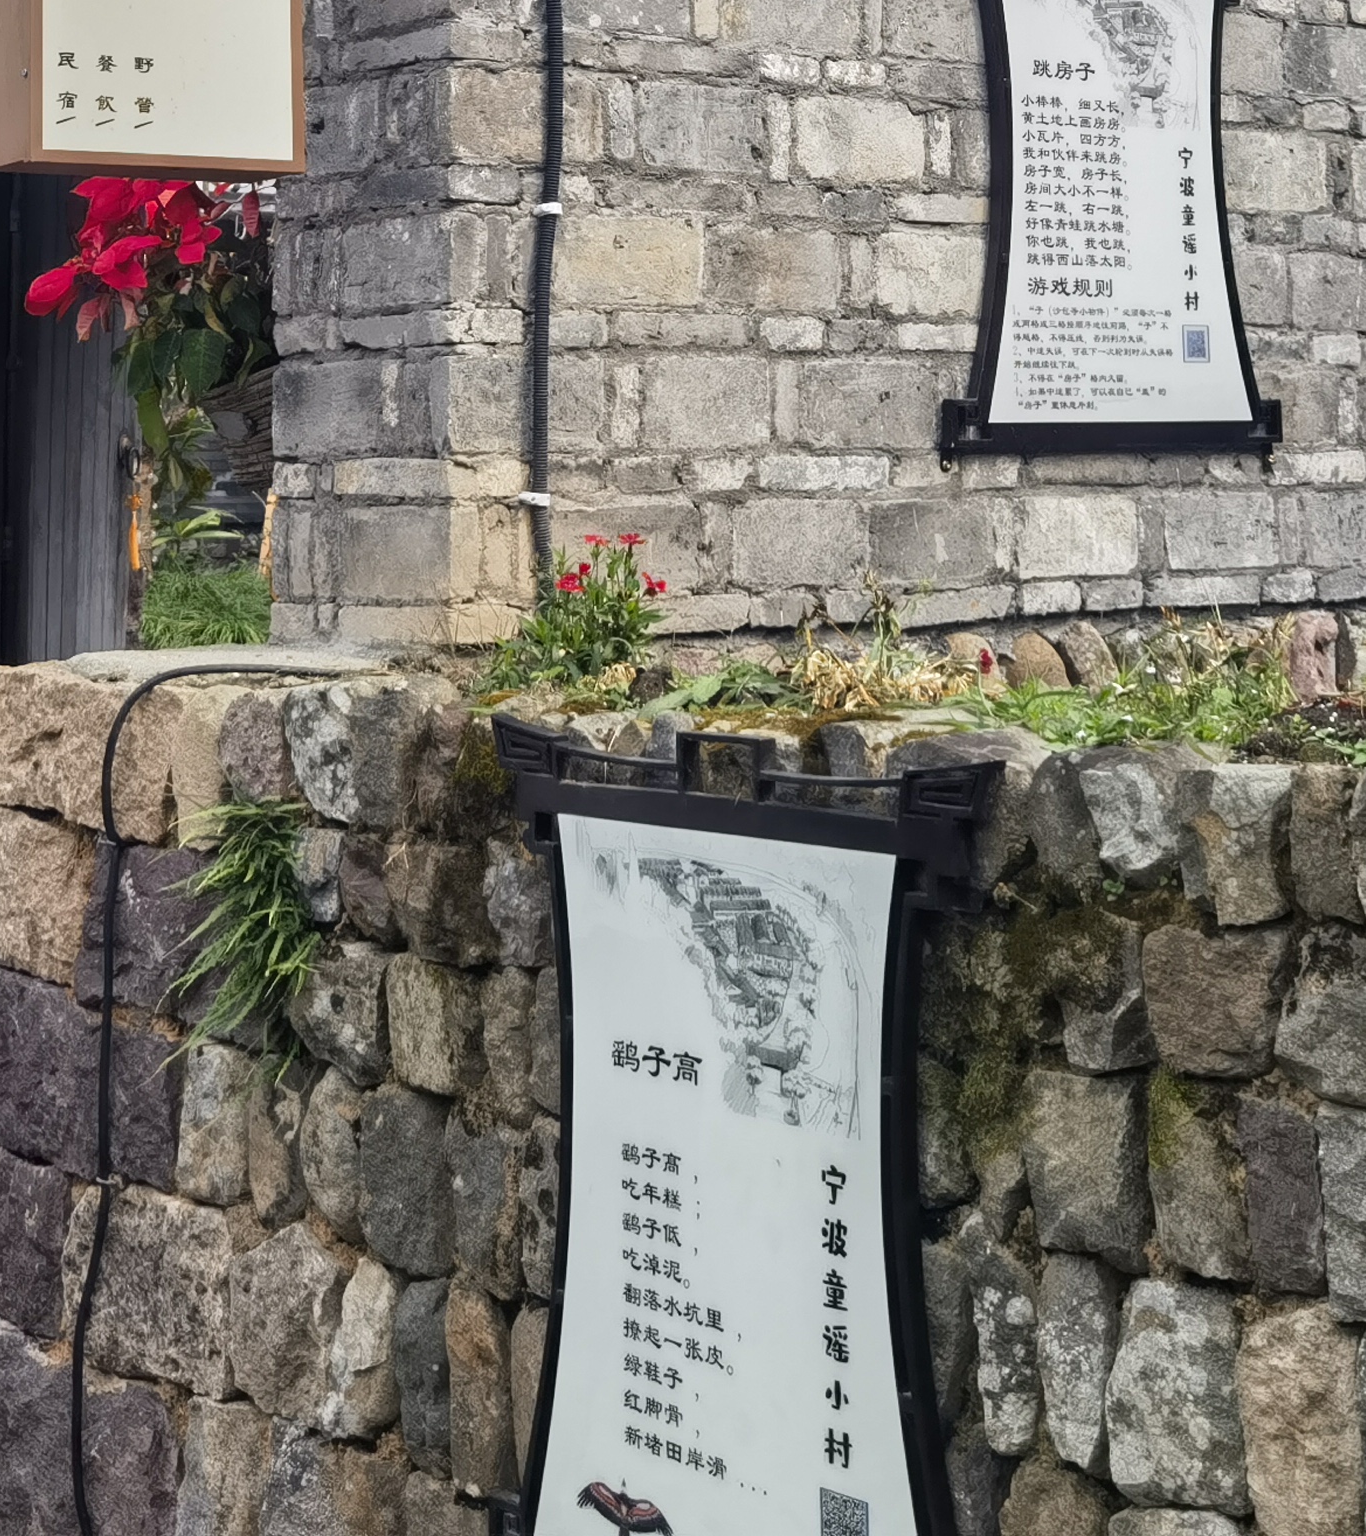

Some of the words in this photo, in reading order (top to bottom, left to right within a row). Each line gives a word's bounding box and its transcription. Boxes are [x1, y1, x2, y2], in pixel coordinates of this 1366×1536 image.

[56, 52, 79, 110] 民宿
[1032, 59, 1095, 81] 跳房子
[1178, 147, 1199, 311] 宁波童谣小村
[1028, 276, 1113, 298] 游戏规则
[611, 1039, 703, 1086] 鹞子高
[821, 1164, 853, 1469] 宁波童谣小村
